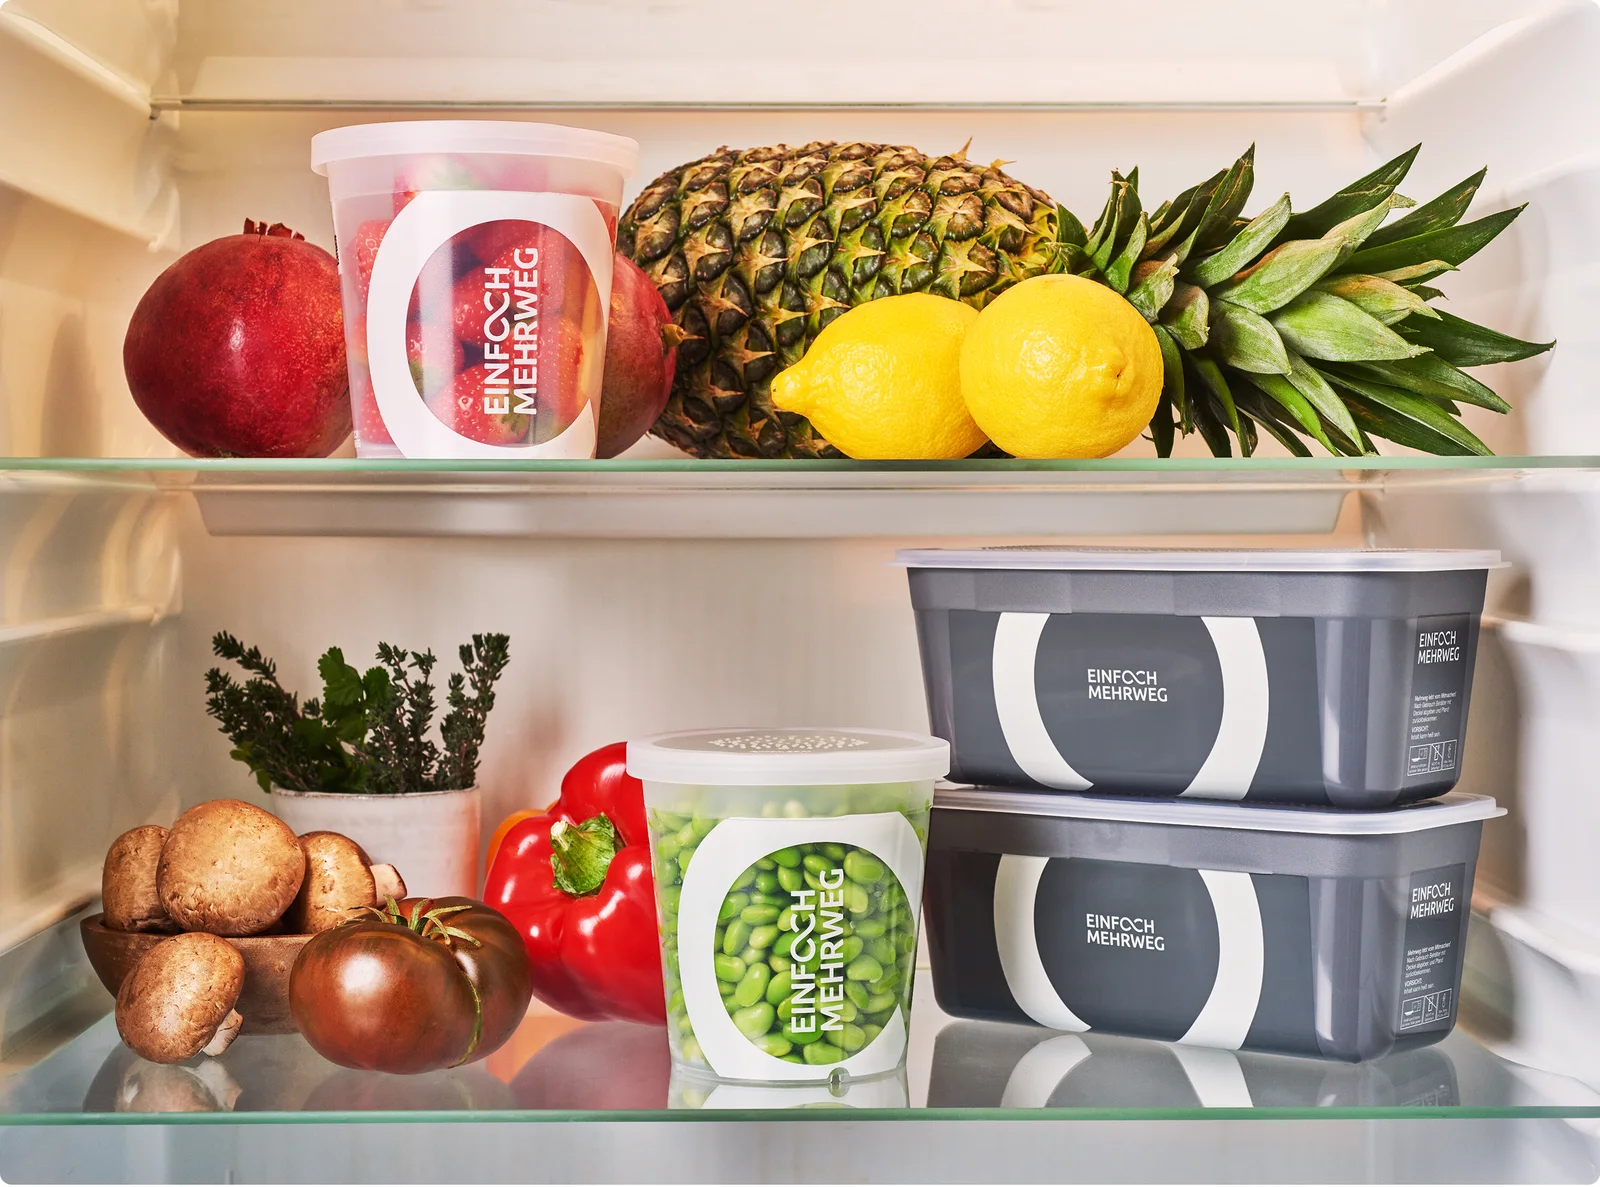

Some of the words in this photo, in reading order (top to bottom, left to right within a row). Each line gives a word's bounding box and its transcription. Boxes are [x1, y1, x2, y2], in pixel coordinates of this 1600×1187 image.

[514, 247, 538, 415] MEHRWEG
[1417, 646, 1460, 665] MEHRWEG
[1088, 685, 1168, 702] MEHRWEG
[1410, 897, 1454, 920] MEHRWEG
[820, 868, 844, 1031] MEHRWEG
[1087, 929, 1165, 951] MEHRWEG
